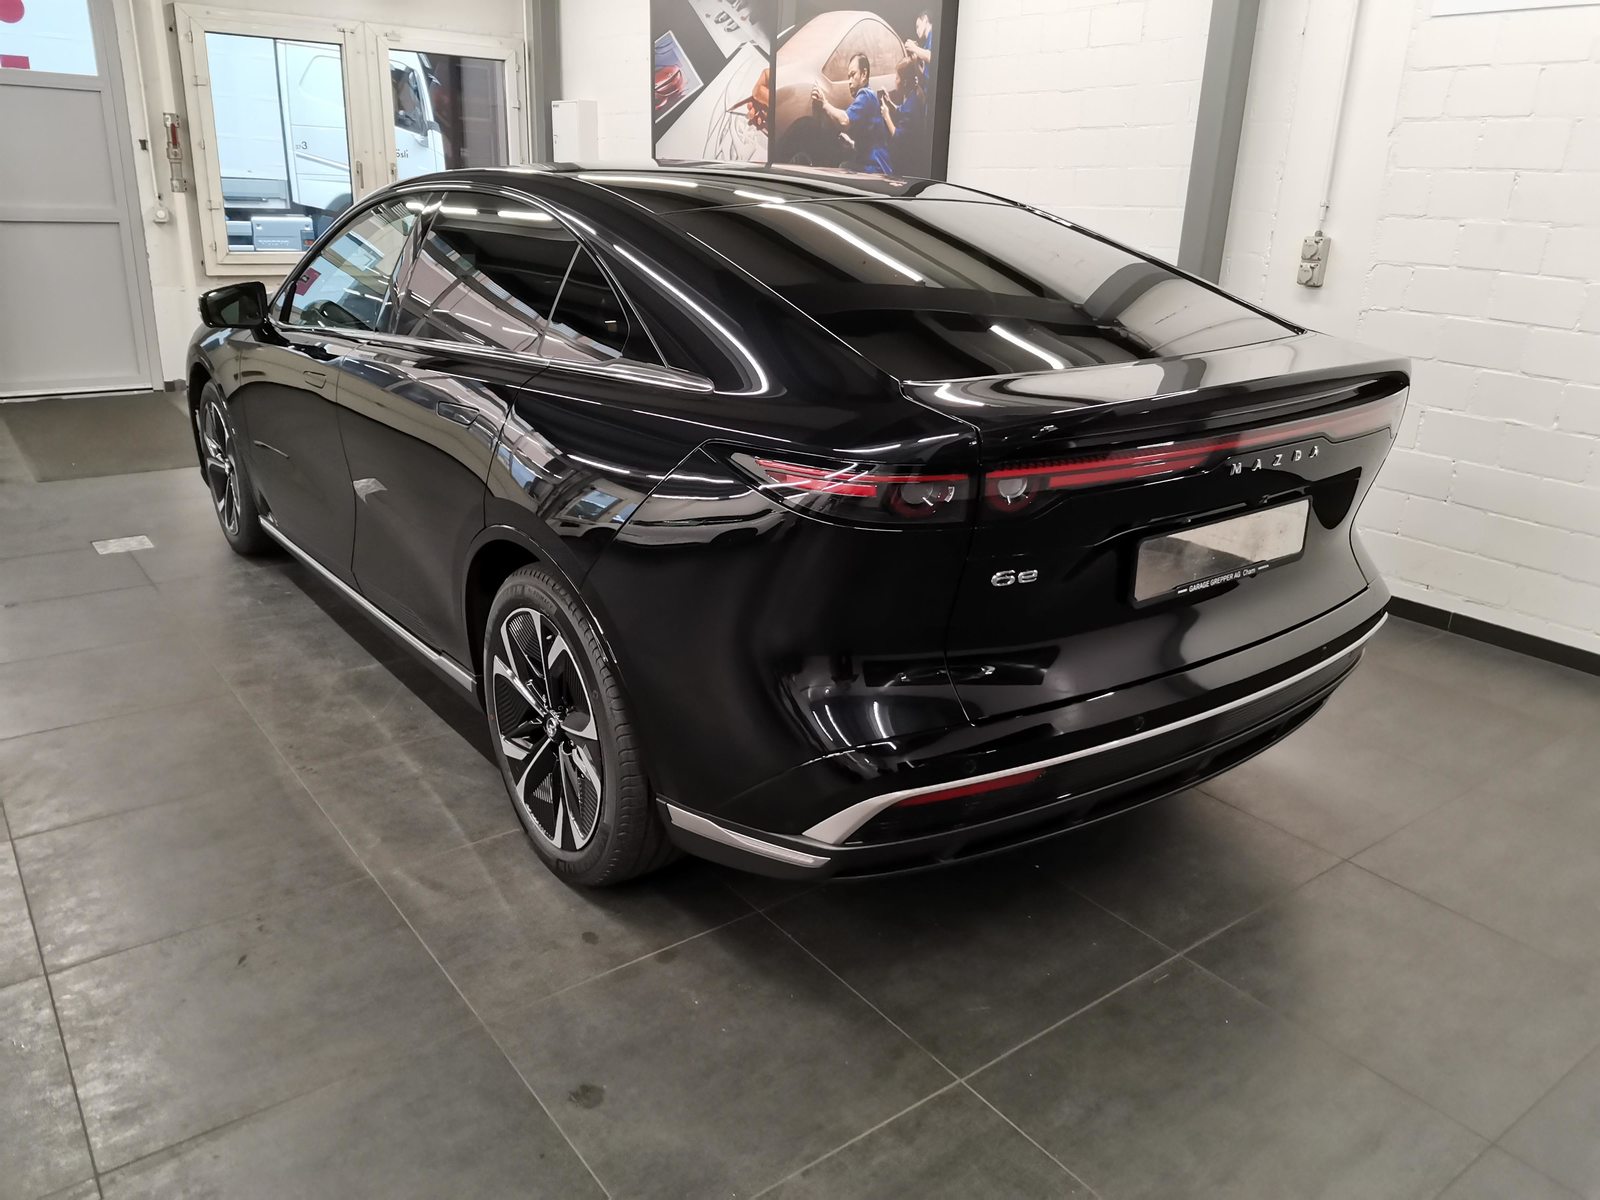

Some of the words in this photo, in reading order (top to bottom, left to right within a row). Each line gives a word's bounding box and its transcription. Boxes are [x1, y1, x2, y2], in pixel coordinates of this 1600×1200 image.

[1229, 445, 1319, 476] MAZDA
[991, 569, 1038, 587] 6e
[1188, 581, 1210, 593] GARAGE
[1233, 570, 1241, 579] AG
